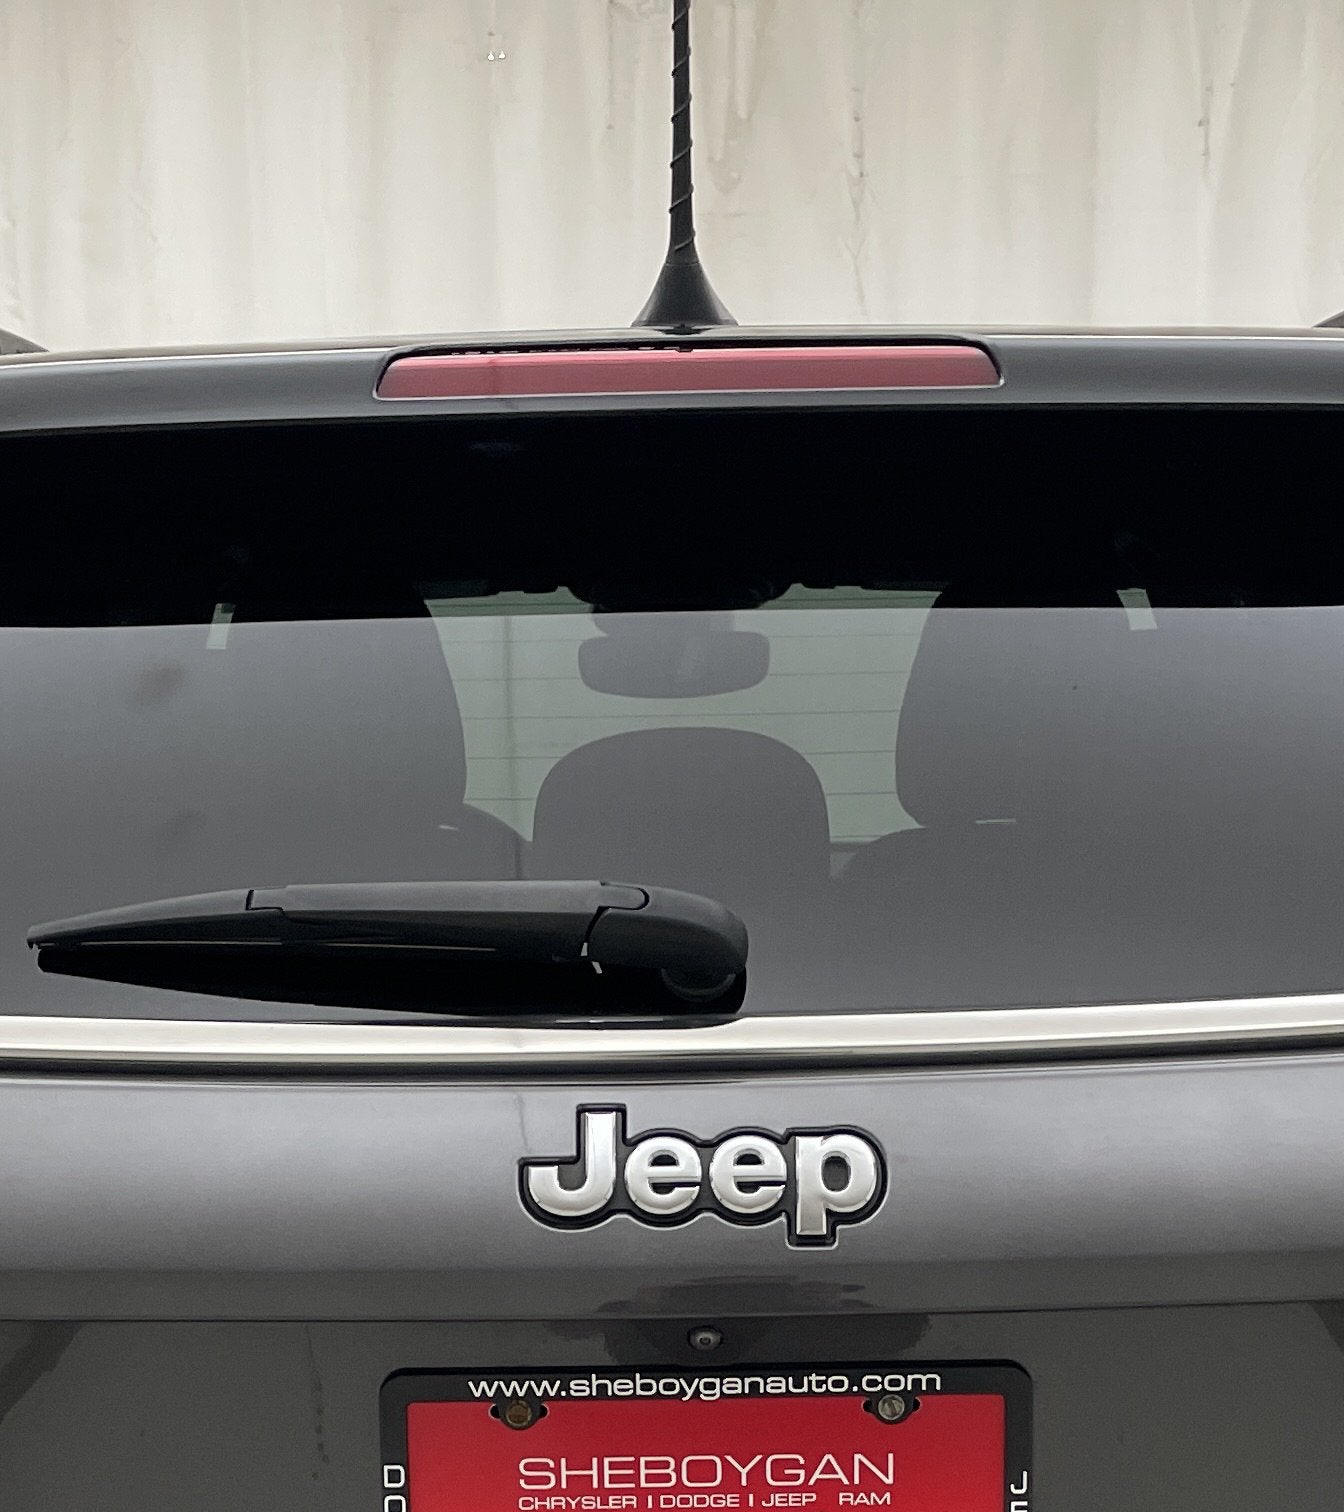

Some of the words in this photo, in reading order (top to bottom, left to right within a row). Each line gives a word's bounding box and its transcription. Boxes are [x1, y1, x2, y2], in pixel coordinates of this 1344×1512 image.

[526, 1109, 879, 1237] Jeep
[468, 1372, 942, 1401] www.sheboyganauto.com
[518, 1453, 895, 1490] SHEBOYGAN
[518, 1496, 637, 1511] CHRYSLER
[659, 1494, 740, 1508] DODGE
[761, 1493, 817, 1507] JEEP
[838, 1491, 891, 1506] RAM
